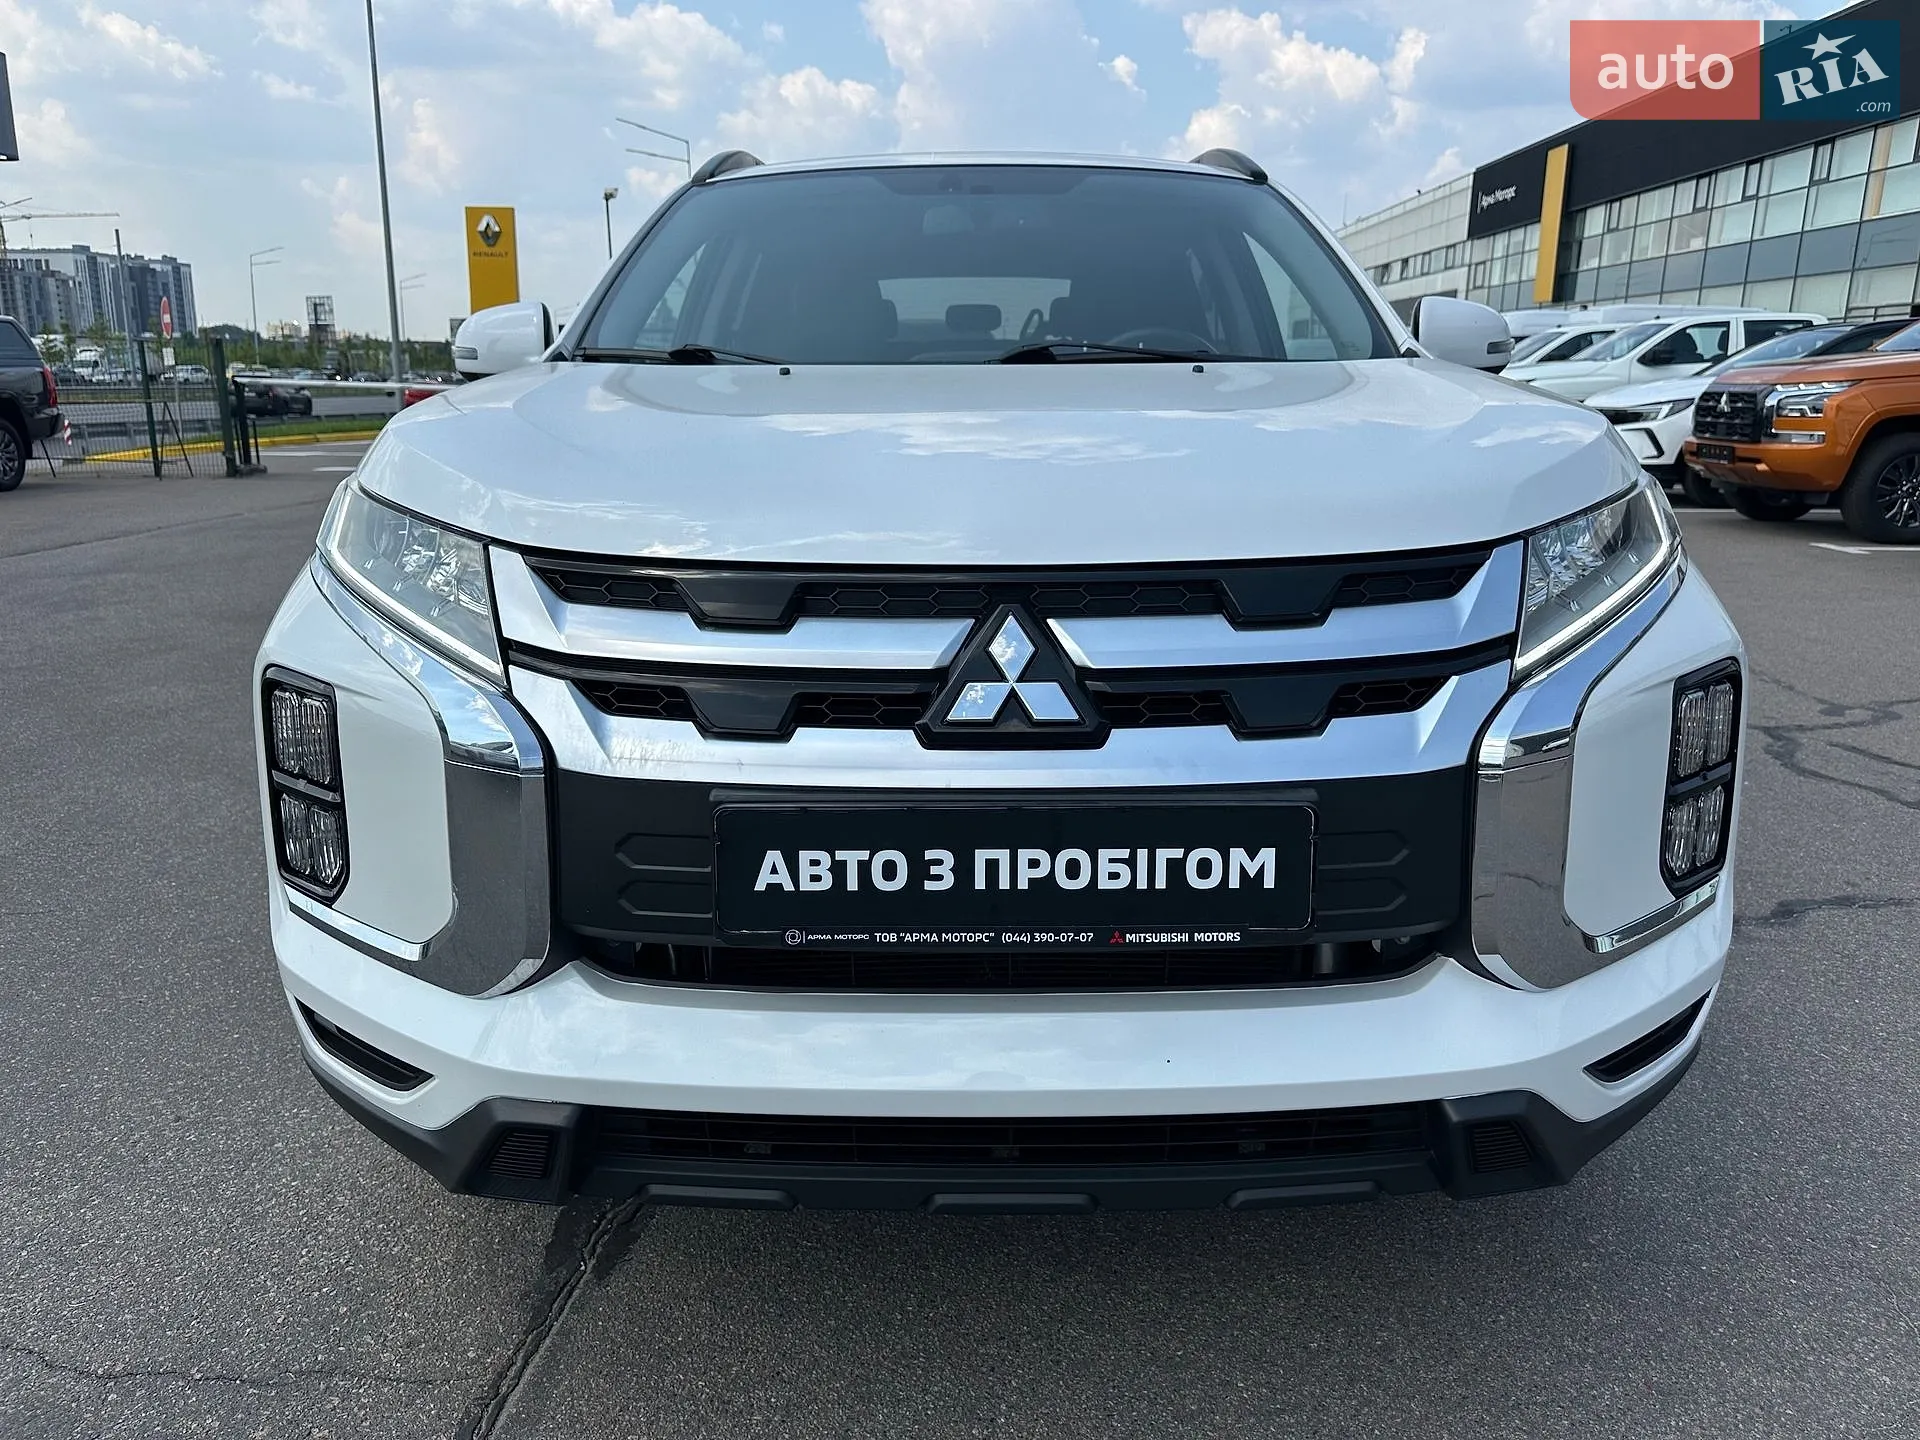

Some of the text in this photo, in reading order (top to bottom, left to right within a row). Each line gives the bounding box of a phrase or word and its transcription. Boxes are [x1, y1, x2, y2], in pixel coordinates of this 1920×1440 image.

[754, 850, 908, 891] АВТО
[974, 847, 1277, 890] ПРОБІГОМ
[874, 932, 897, 942] ТОВ
[1001, 932, 1031, 943] (044)
[1033, 932, 1094, 942] 390-07-07
[1125, 932, 1241, 943] MITSUBISHI MOTORS
